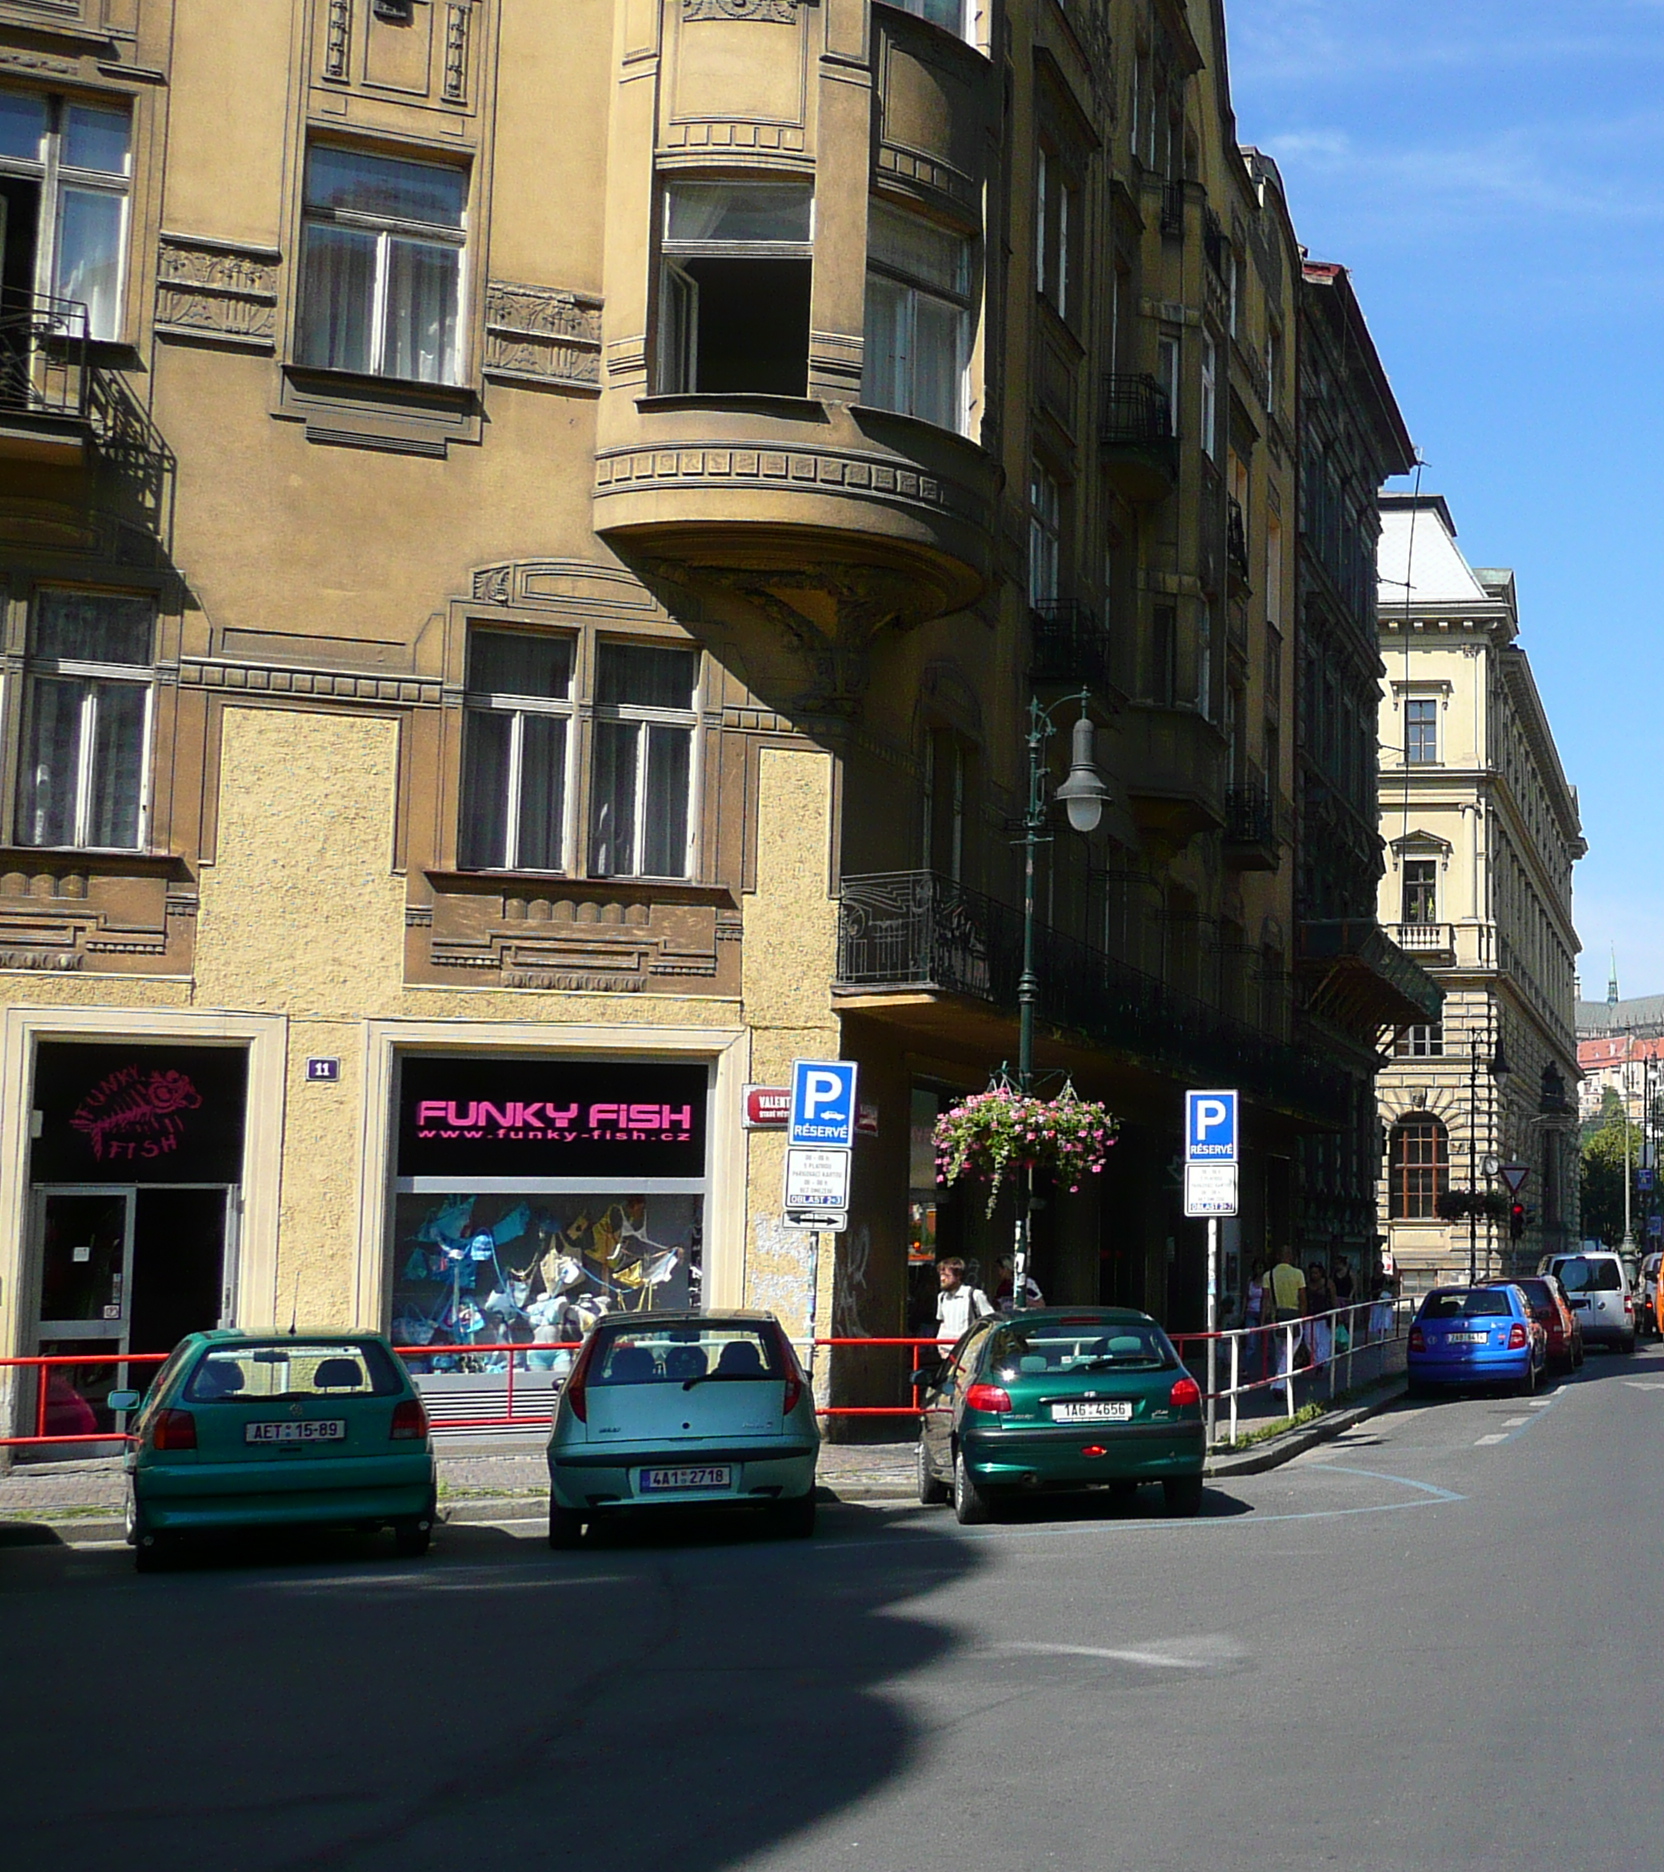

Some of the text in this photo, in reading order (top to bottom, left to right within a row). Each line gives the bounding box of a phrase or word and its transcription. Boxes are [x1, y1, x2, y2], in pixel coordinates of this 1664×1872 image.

[315, 1062, 330, 1076] 11
[758, 1096, 792, 1109] VALENT
[804, 1070, 843, 1120] P
[417, 1101, 578, 1127] FUNKY
[1197, 1100, 1227, 1140] P
[418, 1128, 691, 1142] www.funky-fish.cz
[794, 1123, 849, 1139] RÉSERVÉ
[108, 1134, 178, 1159] FISH
[1190, 1143, 1234, 1155] RÉSERVÉ
[1065, 1402, 1126, 1416] 1A6 4656
[254, 1422, 338, 1439] AET 15-89
[653, 1469, 724, 1485] 4A1 2718
